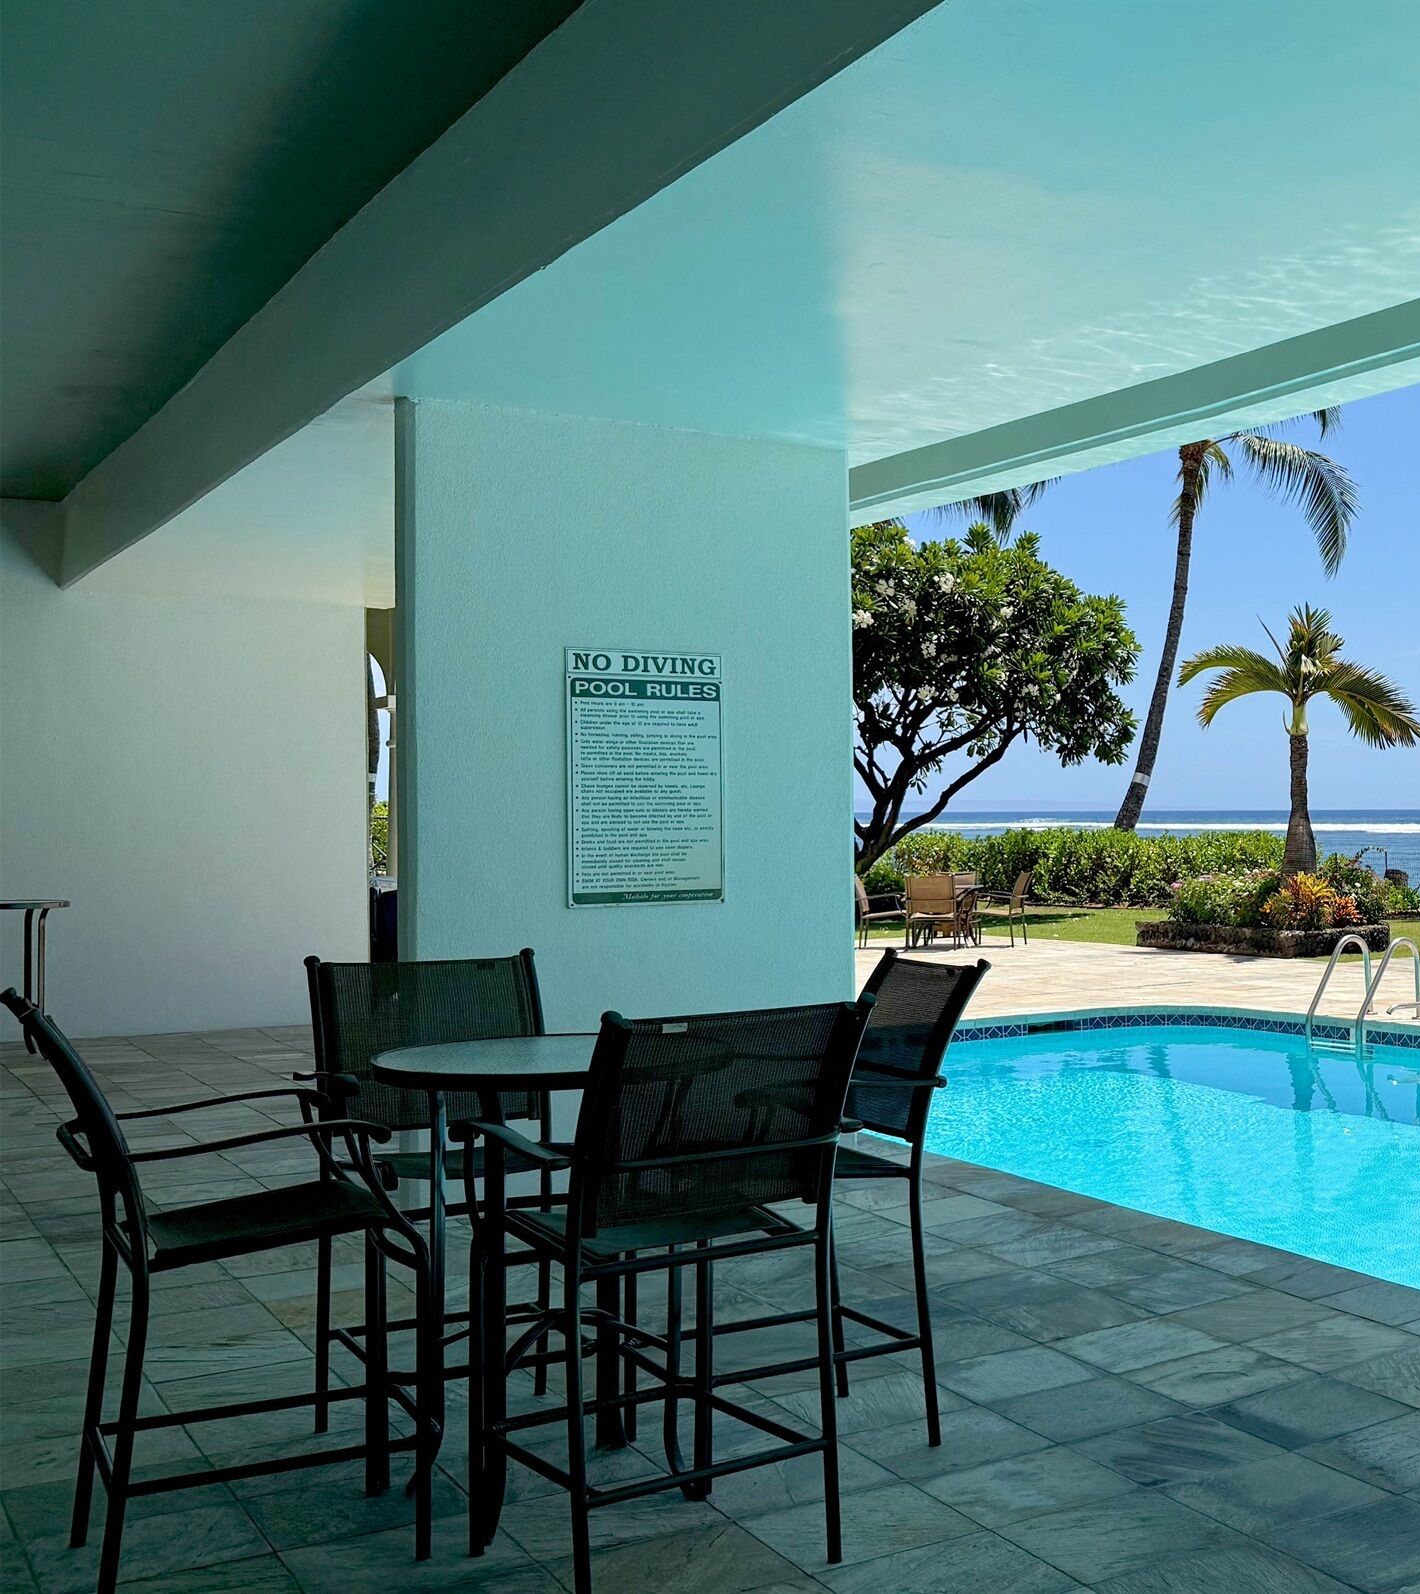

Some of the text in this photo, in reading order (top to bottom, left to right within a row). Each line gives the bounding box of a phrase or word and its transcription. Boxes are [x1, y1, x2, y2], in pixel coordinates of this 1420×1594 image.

[572, 653, 716, 676] NO DIVING
[575, 680, 716, 698] POOL RULES
